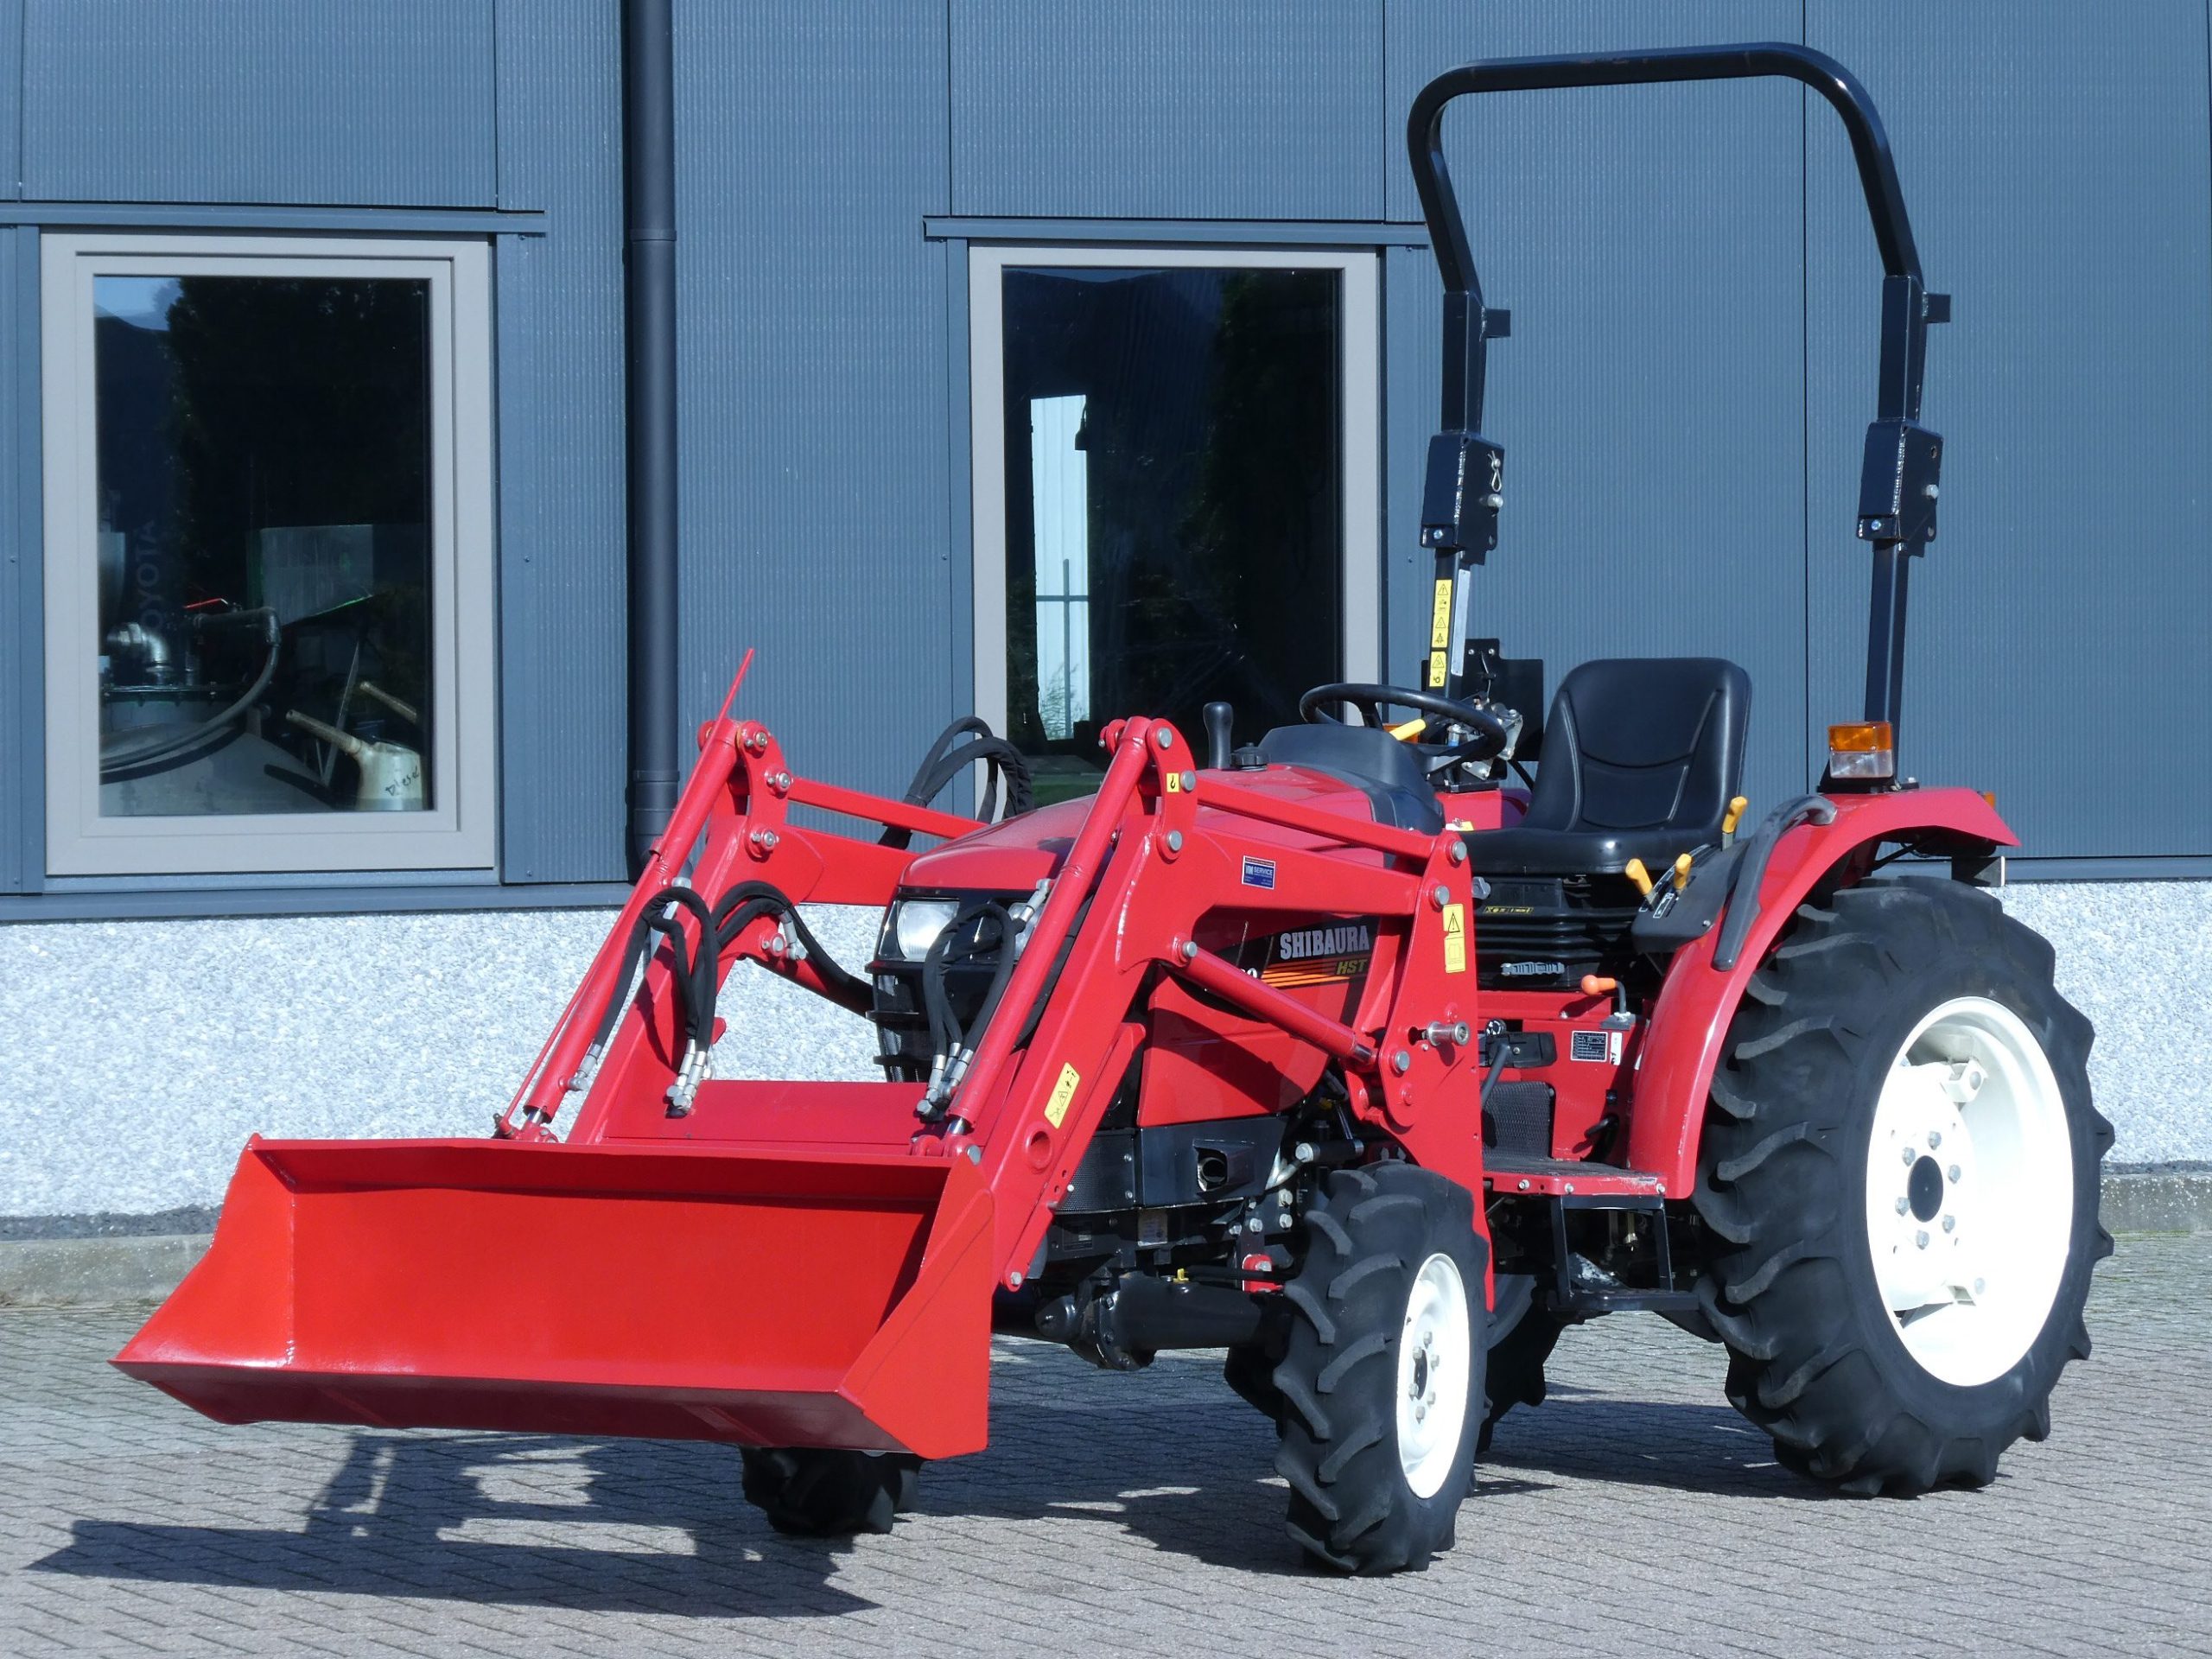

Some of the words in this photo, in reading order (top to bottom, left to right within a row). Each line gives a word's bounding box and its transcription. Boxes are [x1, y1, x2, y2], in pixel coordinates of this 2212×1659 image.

[135, 519, 163, 630] OYOTA
[1280, 925, 1370, 960] SHIBAURA
[1337, 959, 1368, 975] HST
